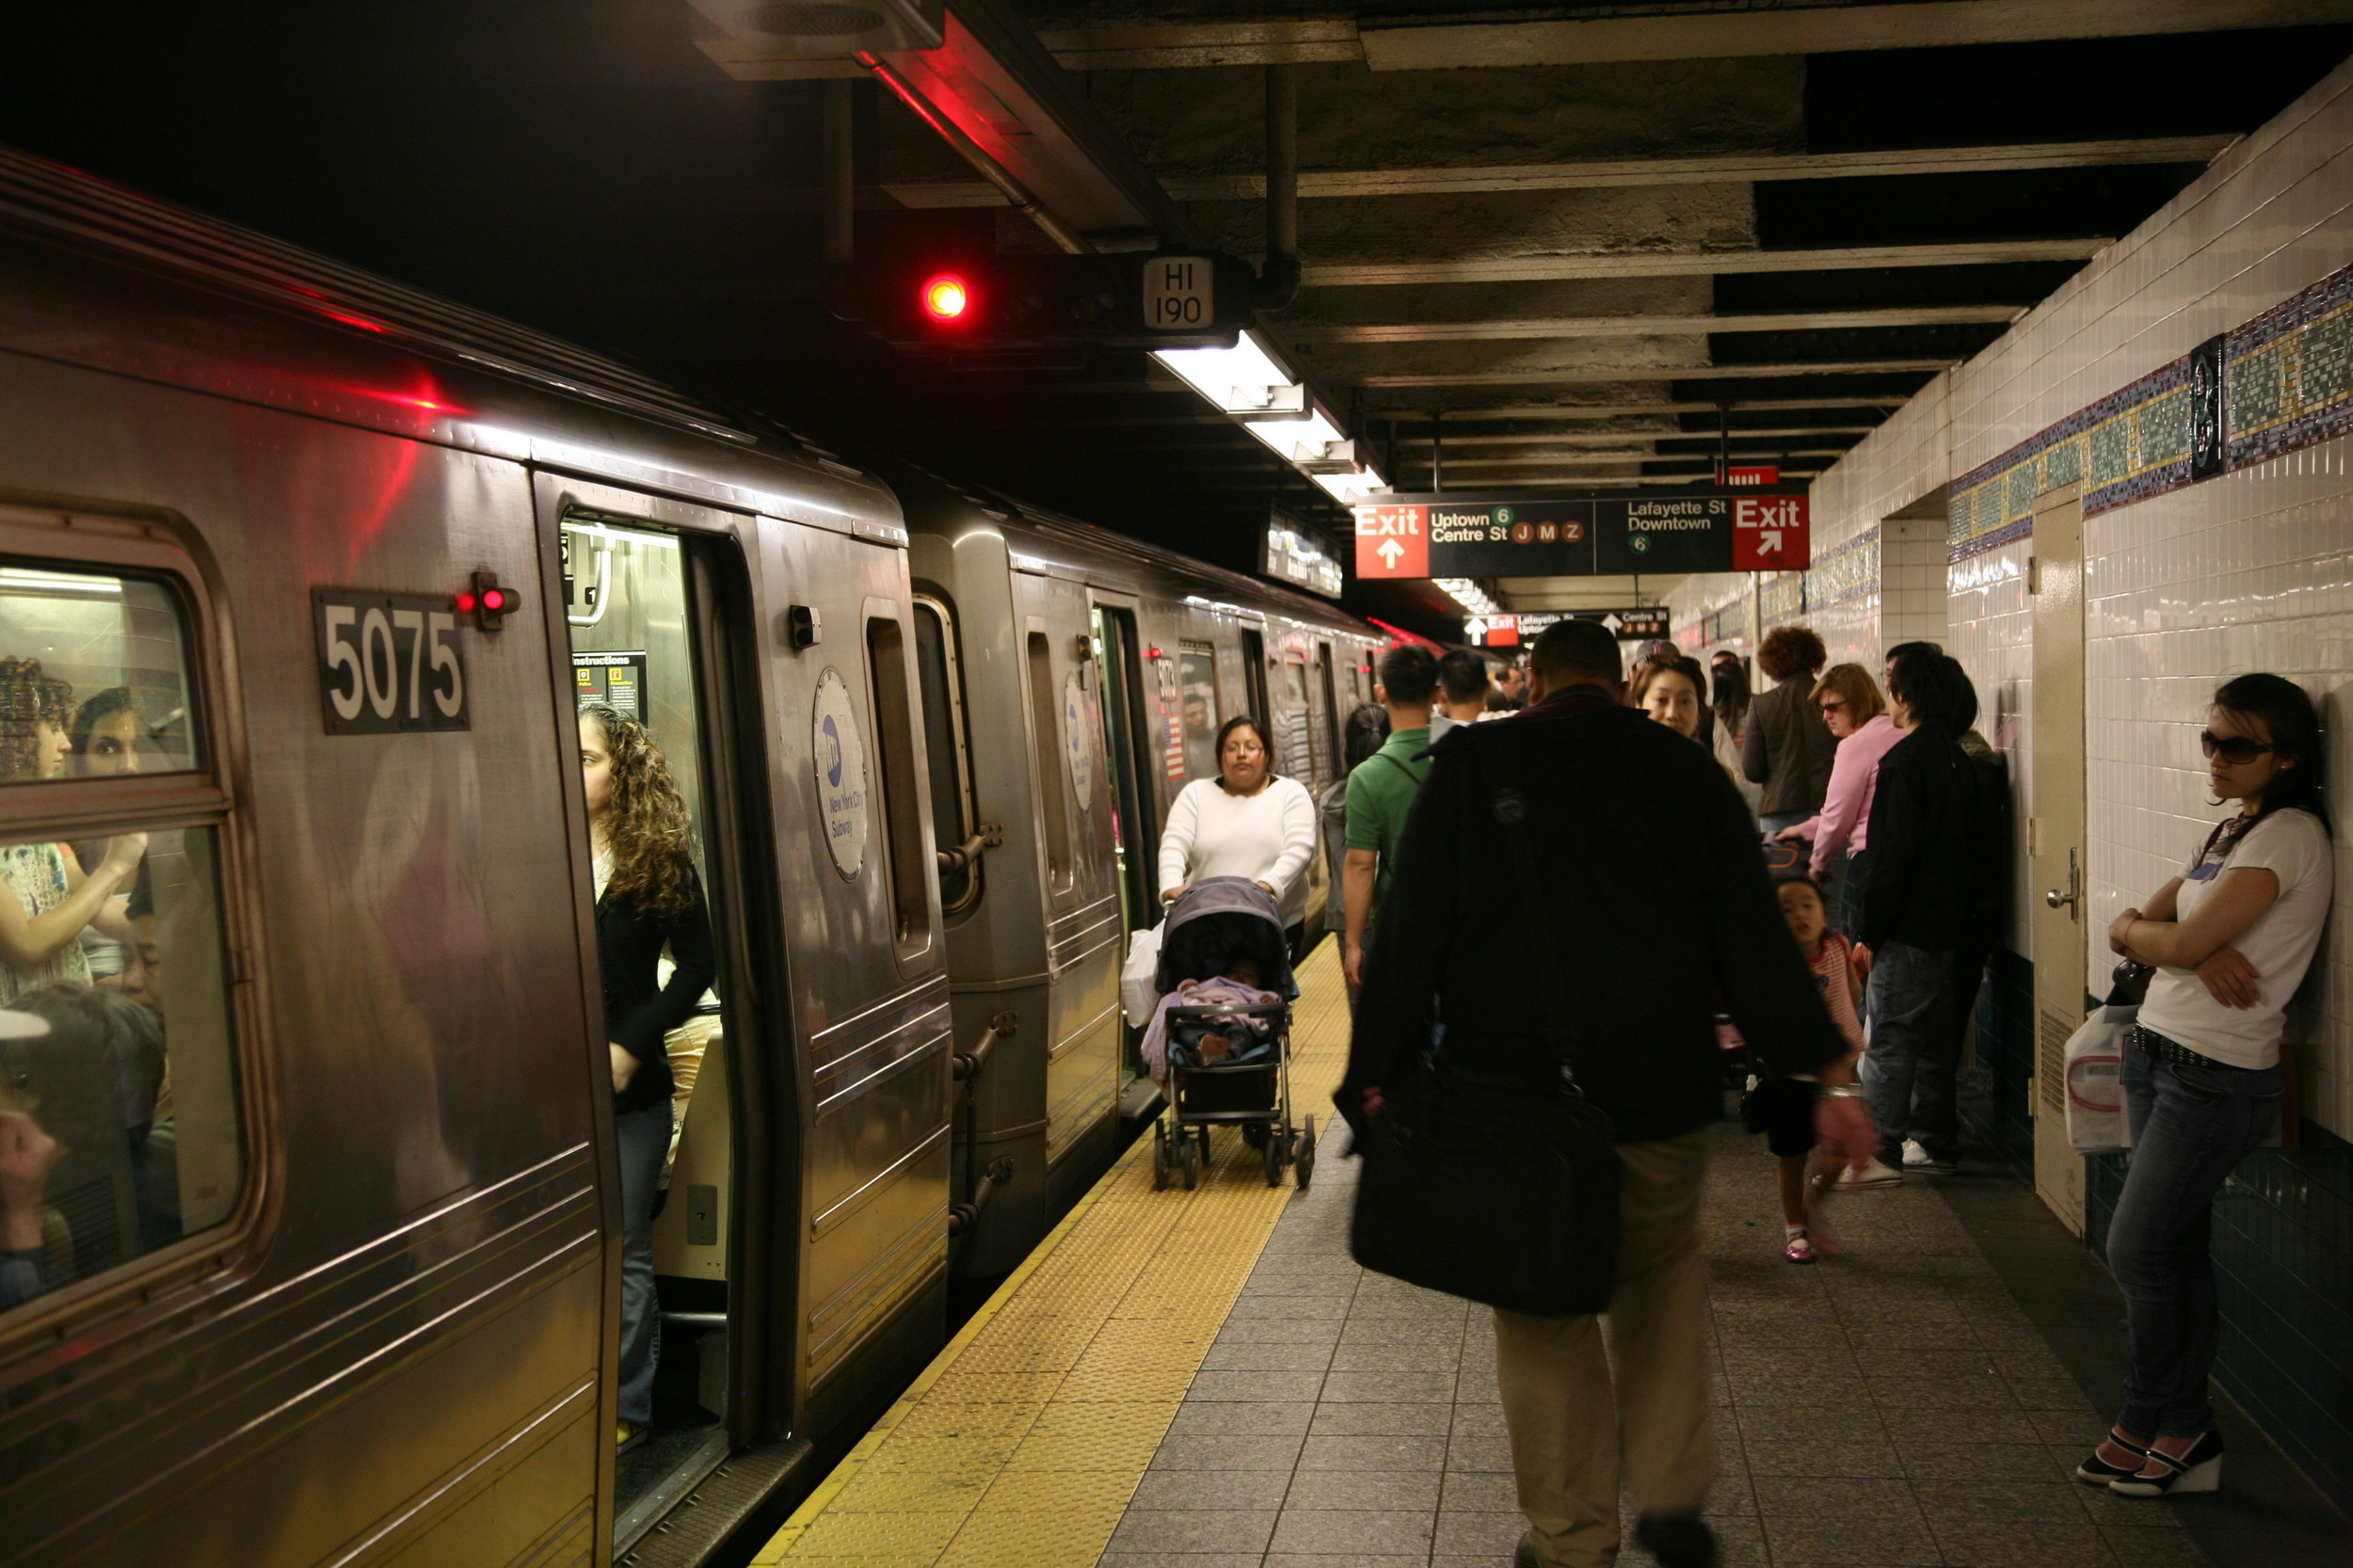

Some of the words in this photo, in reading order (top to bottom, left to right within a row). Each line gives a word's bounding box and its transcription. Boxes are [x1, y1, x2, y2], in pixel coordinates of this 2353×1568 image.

[1165, 264, 1193, 290] HI
[1157, 296, 1201, 324] 190
[1628, 501, 1703, 518] Lafayette
[1708, 500, 1727, 515] St
[1737, 500, 1800, 528] Exit
[1355, 507, 1419, 536] Exit
[1431, 513, 1490, 533] Uptown
[1497, 508, 1510, 523] 6
[1628, 518, 1711, 531] Downtown
[1431, 528, 1484, 542] Centre
[1490, 526, 1508, 541] St
[1540, 525, 1555, 539] M
[1566, 524, 1579, 538] Z
[1635, 536, 1646, 552] 6
[1488, 616, 1515, 630] Exit
[1622, 612, 1654, 622] Centre
[1657, 611, 1667, 621] St
[326, 605, 462, 720] 5075
[829, 796, 842, 814] New
[841, 793, 854, 812] York
[853, 791, 864, 811] City
[832, 820, 853, 840] Subway
